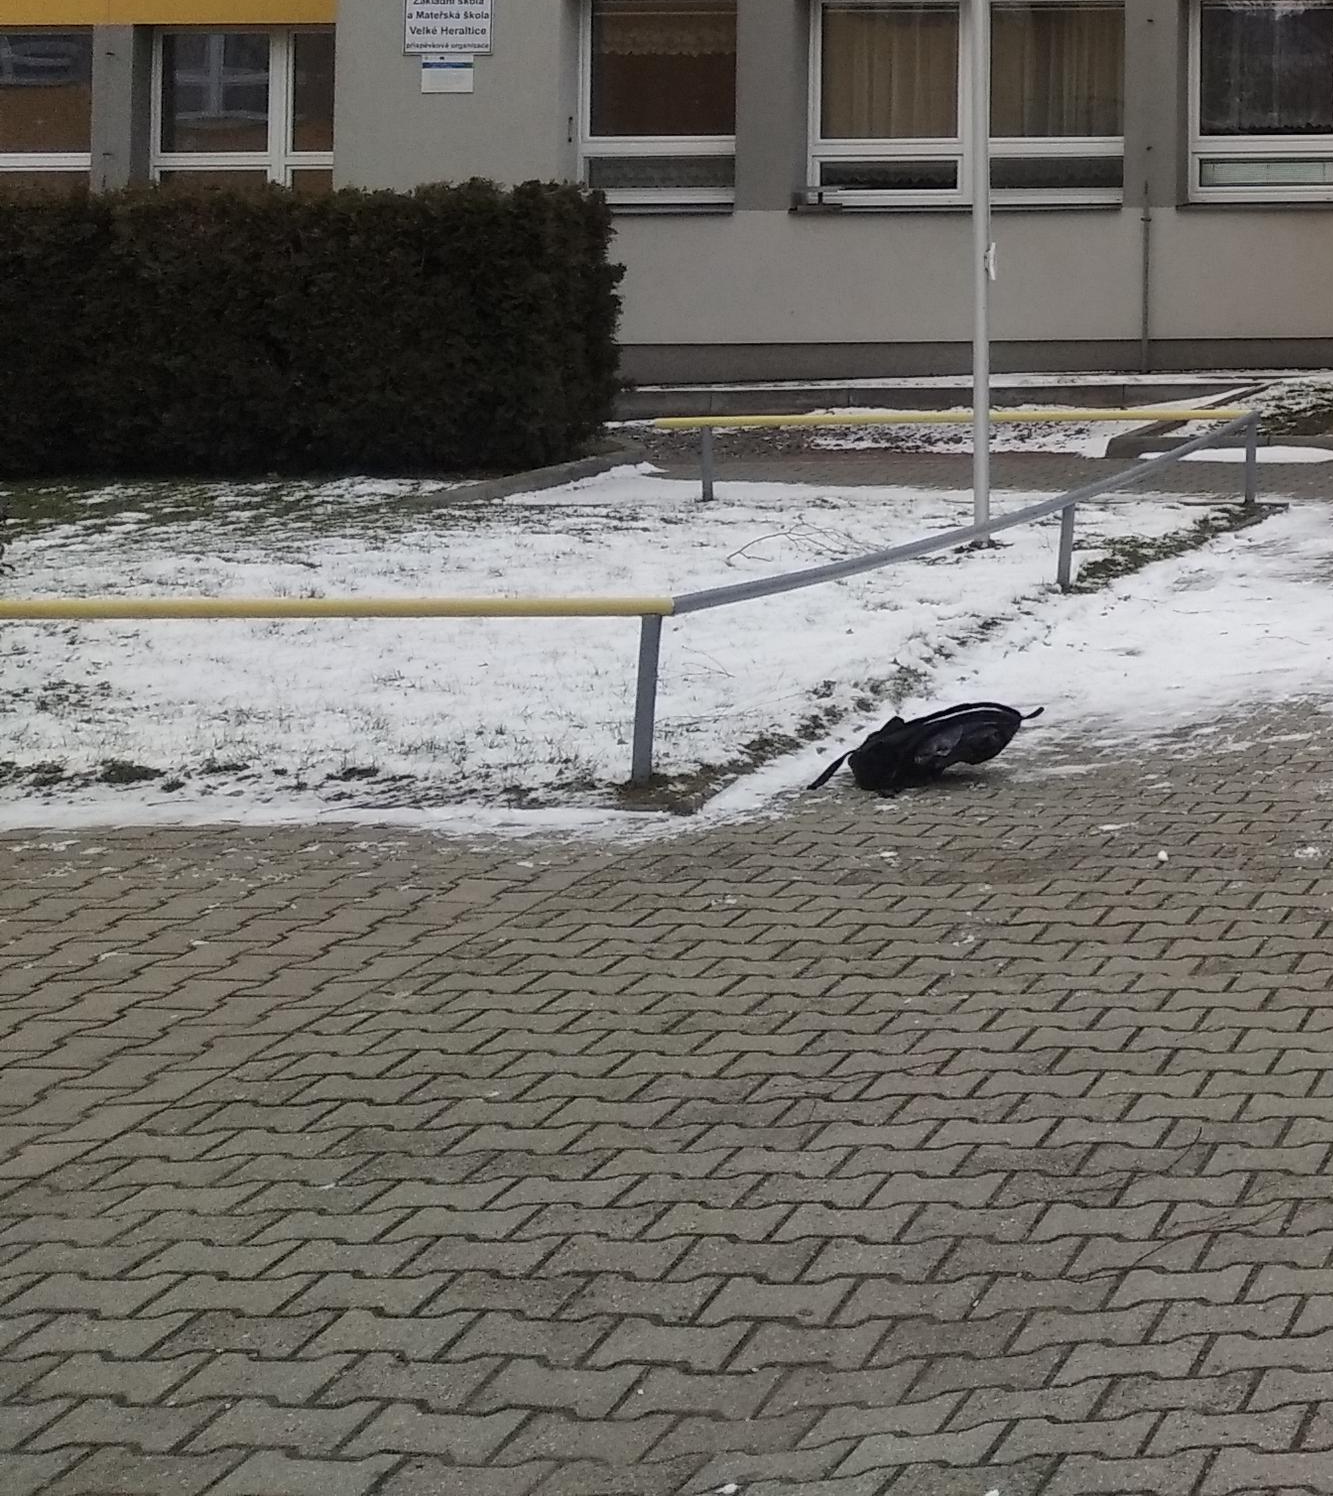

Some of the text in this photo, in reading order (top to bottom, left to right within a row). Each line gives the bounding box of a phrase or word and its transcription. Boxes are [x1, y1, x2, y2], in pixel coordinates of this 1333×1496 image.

[416, 10, 460, 20] Mateřská
[463, 10, 489, 20] škola
[409, 26, 487, 36] Velké Heraltice
